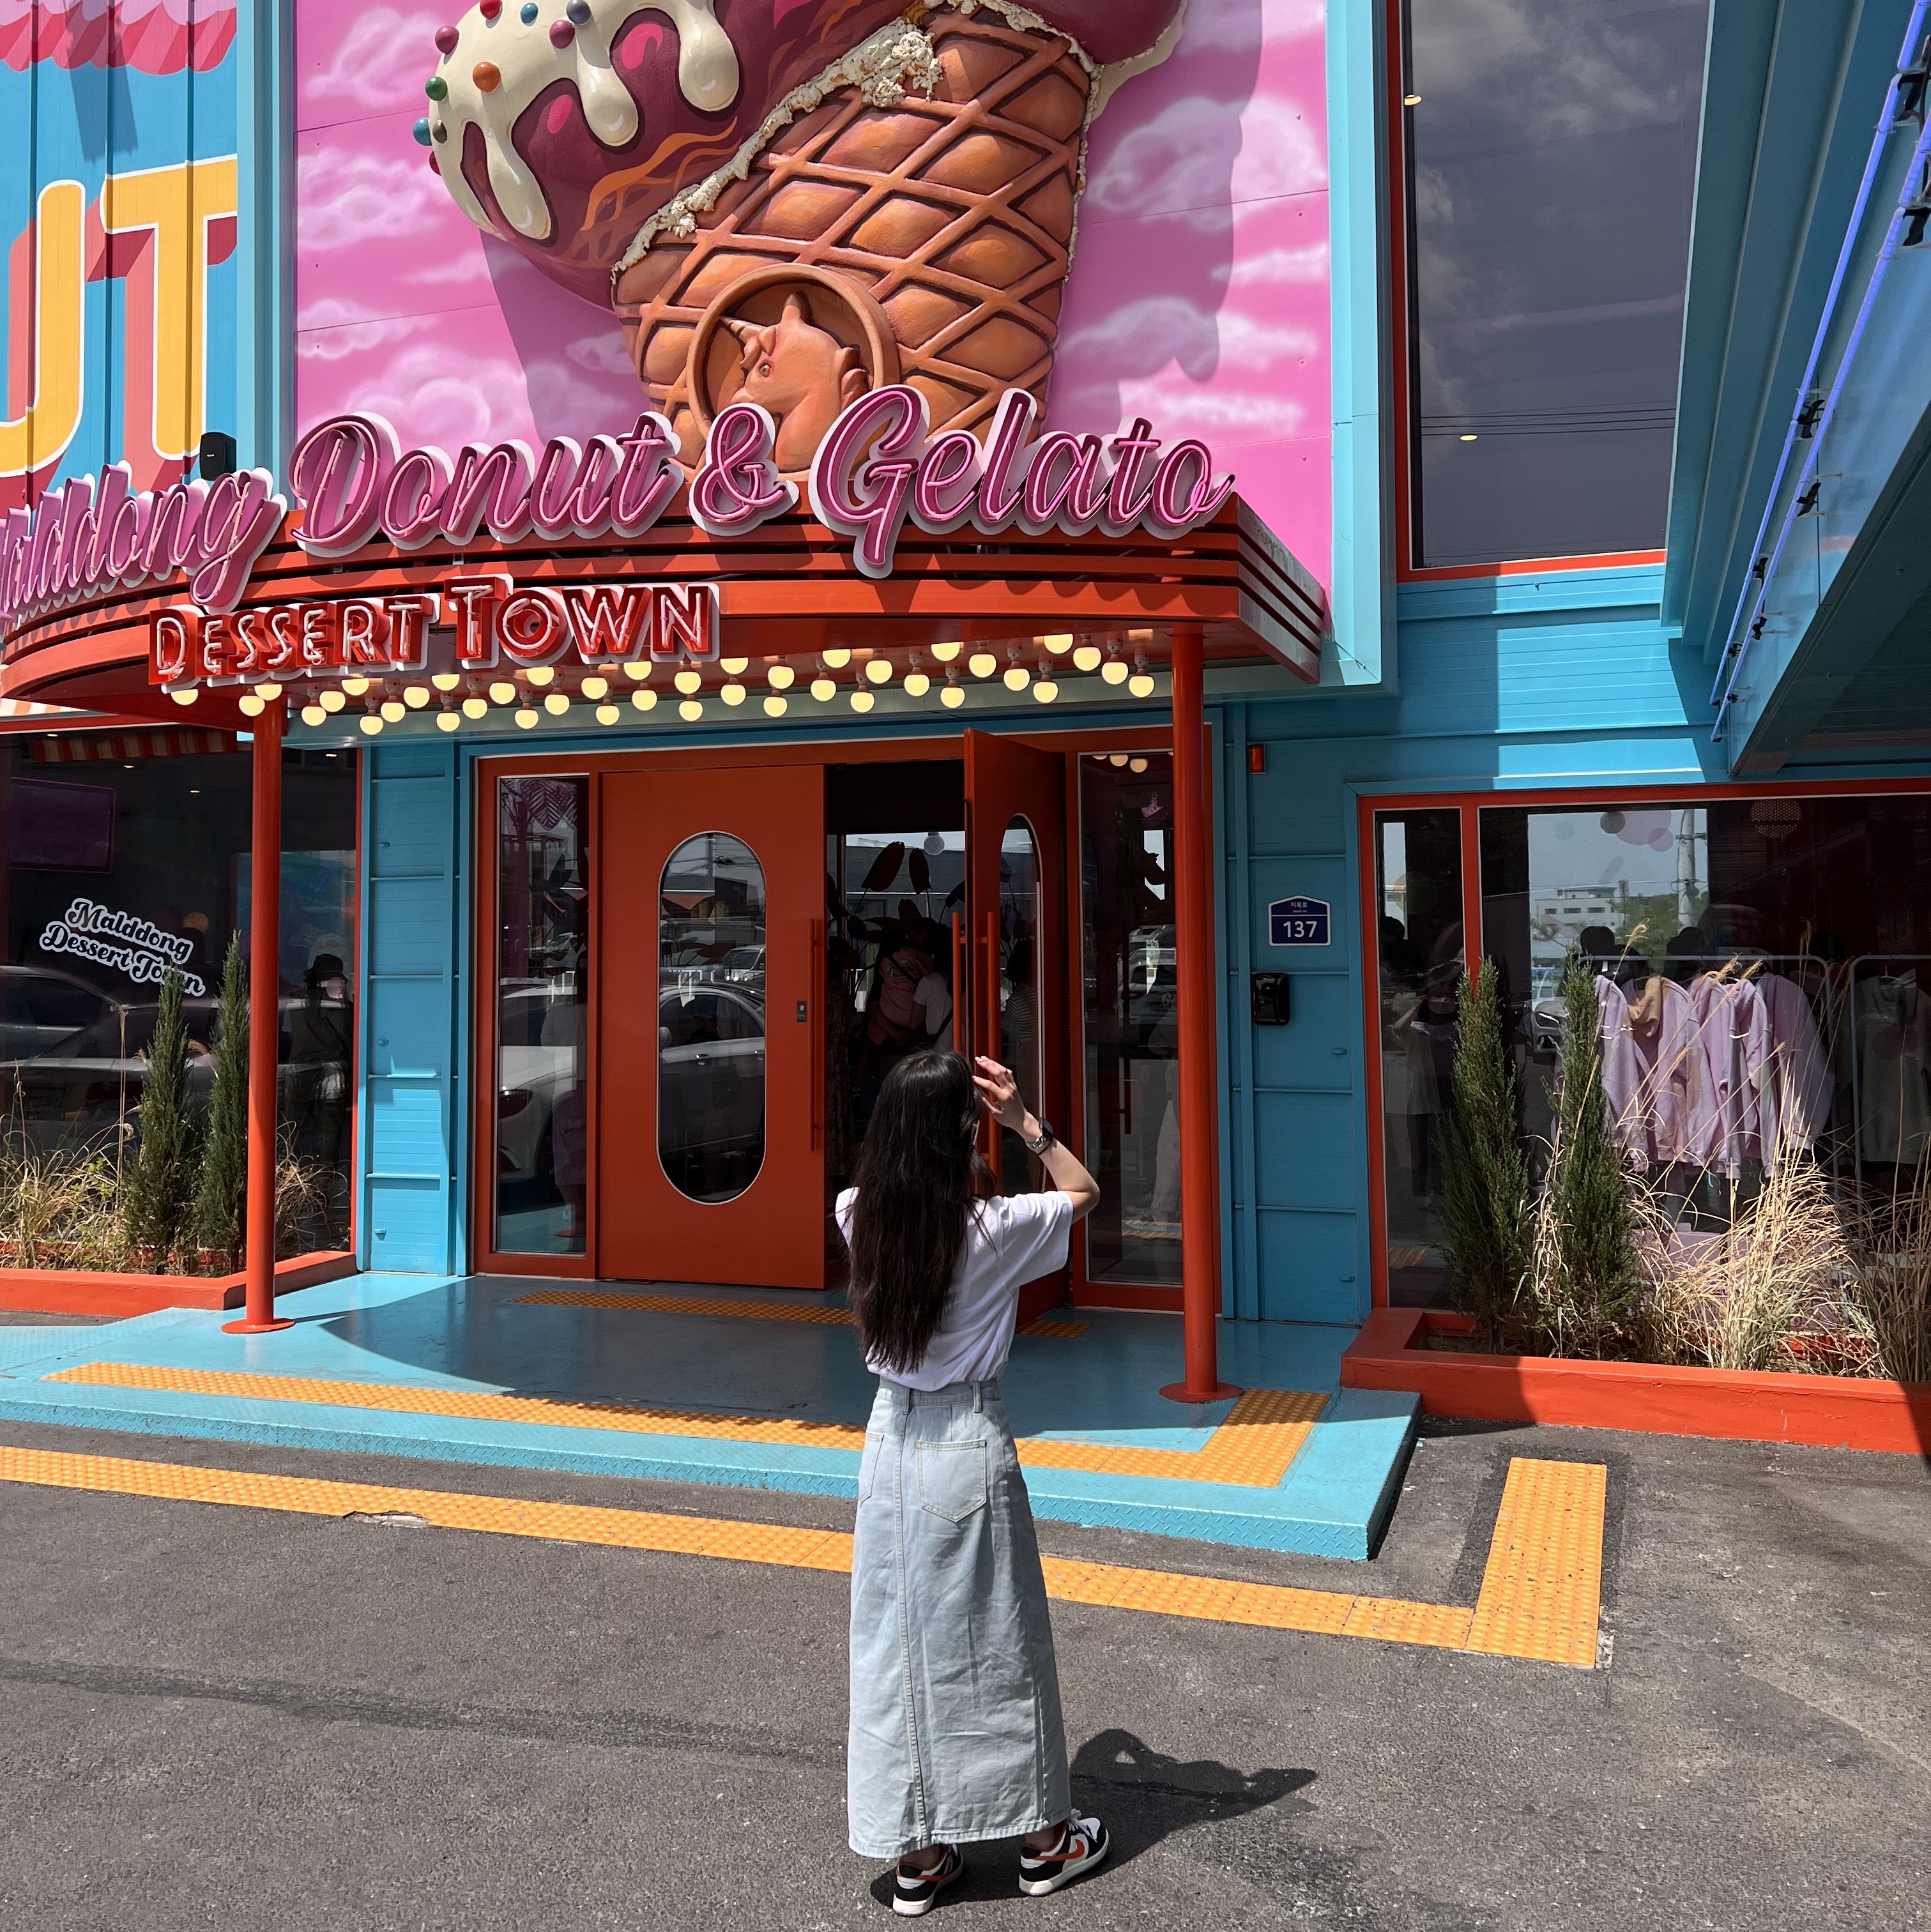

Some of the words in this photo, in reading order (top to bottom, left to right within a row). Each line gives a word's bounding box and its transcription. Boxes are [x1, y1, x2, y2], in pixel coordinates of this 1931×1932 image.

[289, 412, 683, 557] Donut
[689, 402, 798, 535] &
[808, 384, 1235, 578] Gelato
[149, 594, 439, 693] DESSERT
[444, 574, 719, 668] TOWN
[40, 921, 132, 971] Dessert
[130, 950, 206, 996] Ton
[65, 898, 194, 964] Malddong
[1283, 920, 1317, 938] 137
